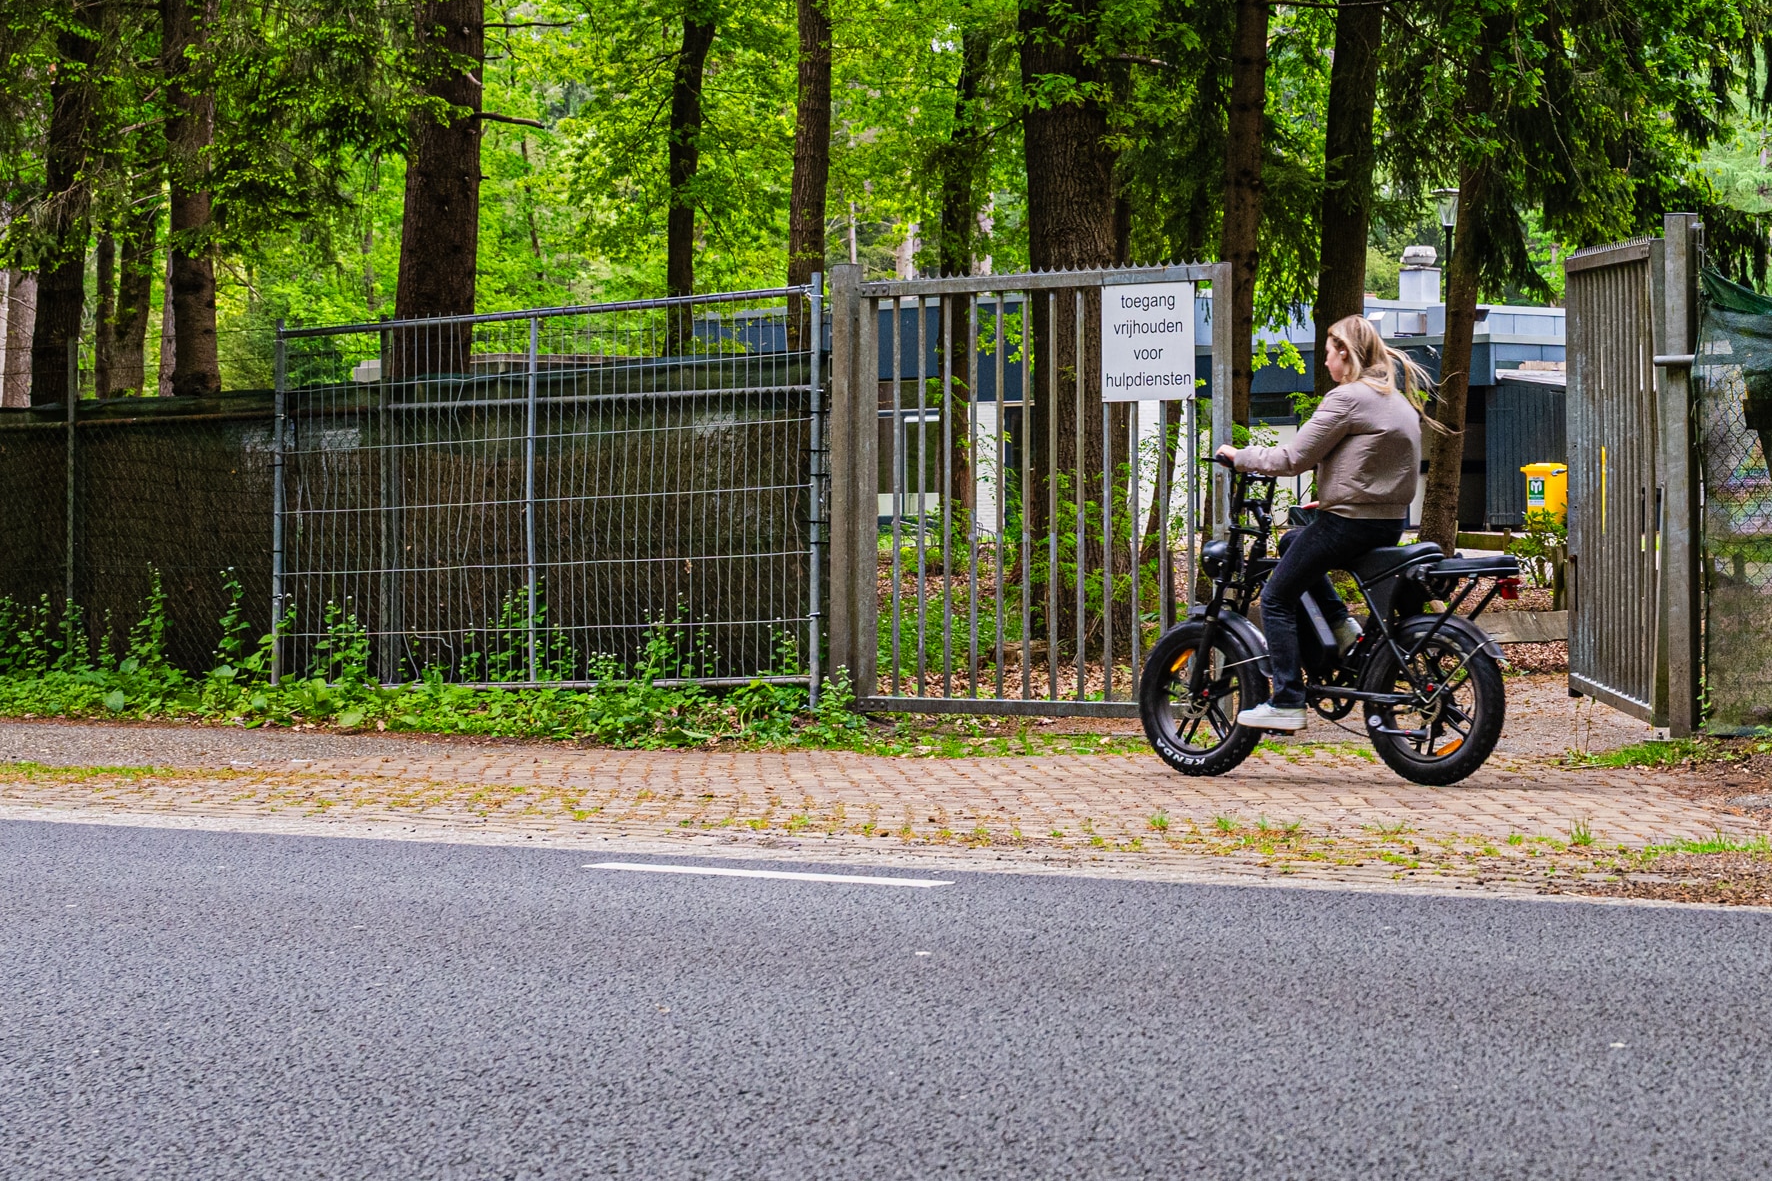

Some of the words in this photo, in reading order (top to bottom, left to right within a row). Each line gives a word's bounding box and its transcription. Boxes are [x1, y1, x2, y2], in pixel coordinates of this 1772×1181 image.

[1121, 295, 1175, 311] toegang
[1114, 318, 1183, 338] vrijhouden
[1133, 347, 1164, 360] voor
[1106, 371, 1191, 390] hulpdiensten
[1156, 737, 1206, 766] KENDA
